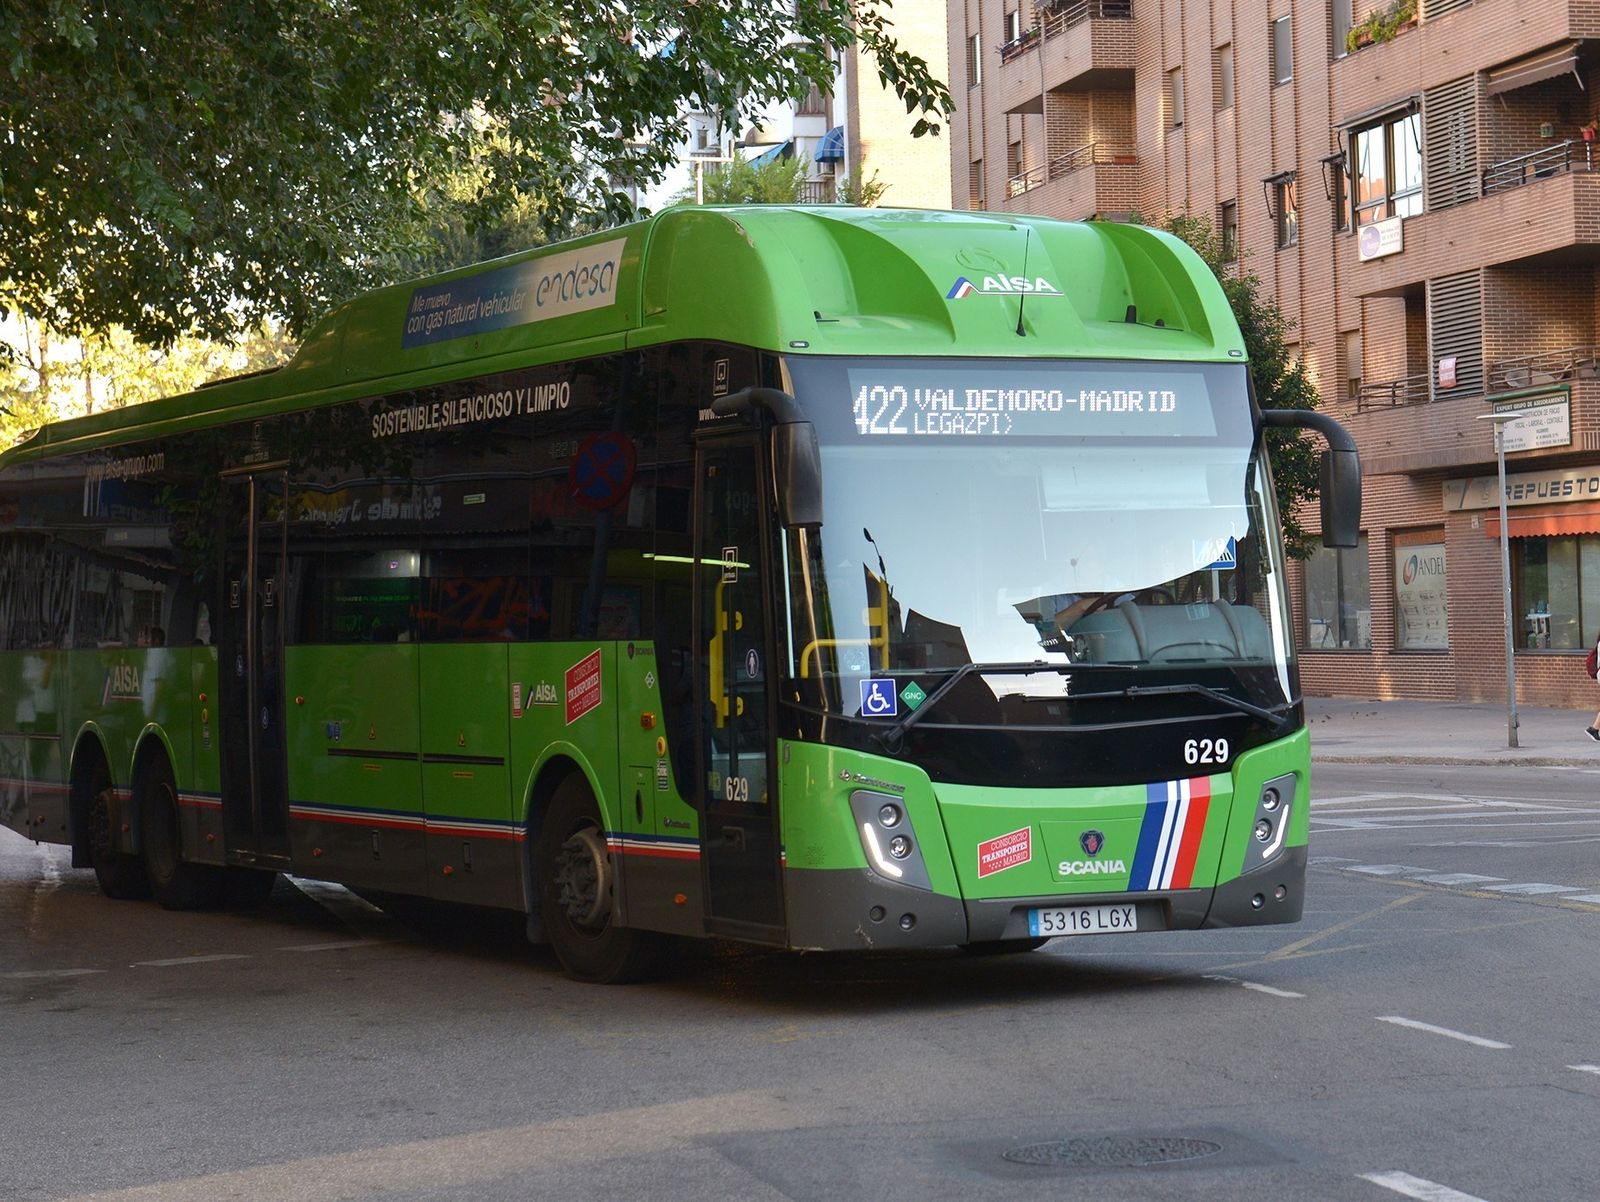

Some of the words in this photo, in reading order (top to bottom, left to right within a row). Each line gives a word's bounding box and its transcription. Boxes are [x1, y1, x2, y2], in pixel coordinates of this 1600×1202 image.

[535, 259, 616, 307] endesa
[407, 316, 426, 334] con
[425, 311, 444, 336] gas
[444, 297, 481, 328] natural
[480, 287, 527, 319] vehicular
[411, 295, 425, 313] Me
[425, 292, 451, 310] muevo
[515, 388, 525, 415] Y
[526, 381, 570, 414] LIMPIO
[853, 385, 908, 435] 422
[904, 691, 922, 700] GNC
[1183, 738, 1230, 764] 629
[726, 776, 748, 802] 629
[981, 841, 1028, 864] TRANSPORTES
[990, 831, 1028, 851] CONSORCIO
[1003, 851, 1028, 867] MADRID
[1057, 860, 1126, 875] SCANIA
[1042, 910, 1092, 931] 5316
[1098, 908, 1133, 929] LGX
